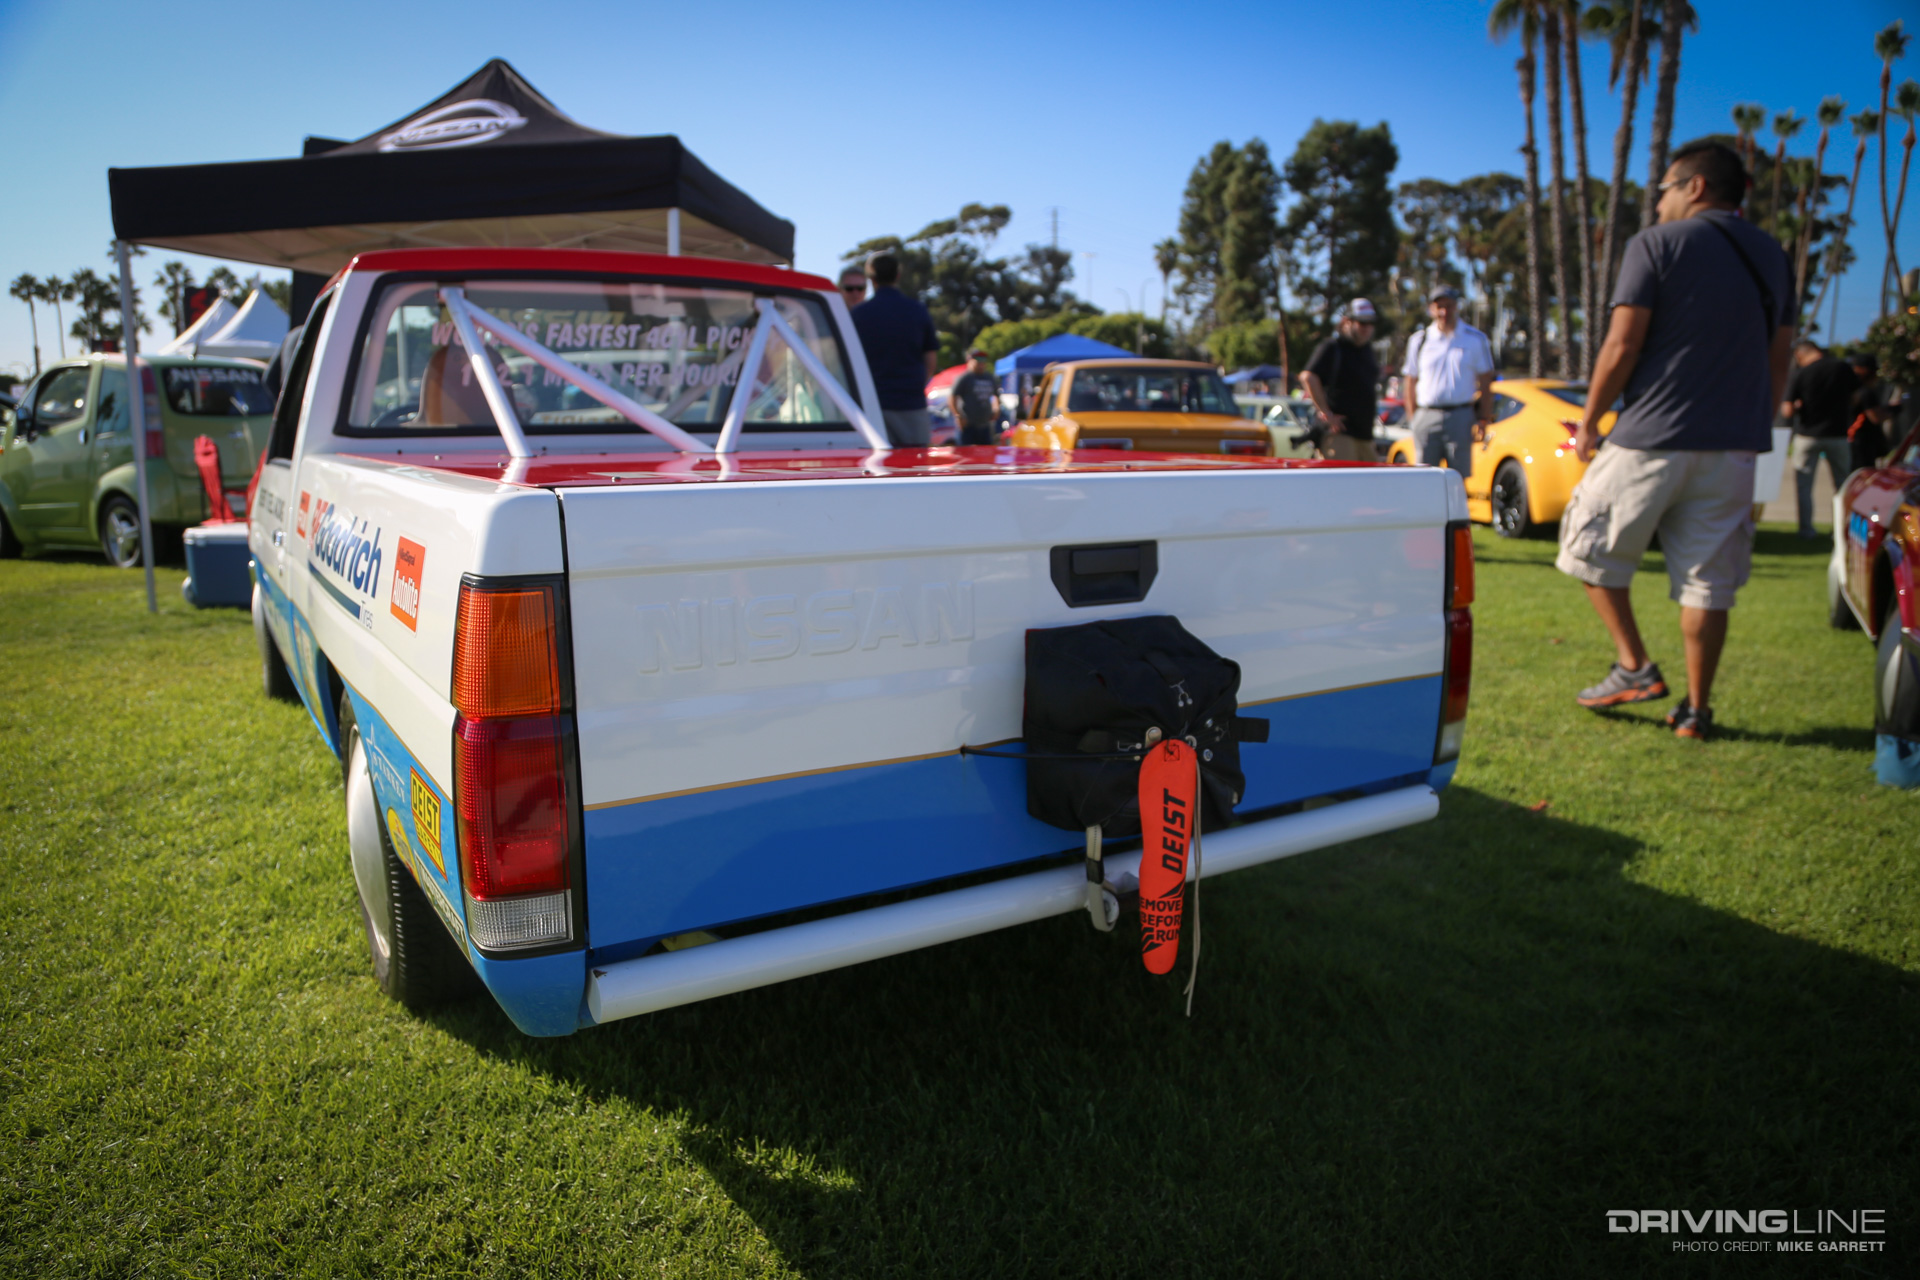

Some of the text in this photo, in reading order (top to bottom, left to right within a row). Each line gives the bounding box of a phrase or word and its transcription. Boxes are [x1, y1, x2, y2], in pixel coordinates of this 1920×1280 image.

[545, 322, 641, 349] FASTEST
[620, 363, 664, 387] PER
[670, 362, 741, 387] HOUR!
[392, 570, 419, 619] Autolite
[634, 580, 975, 675] NISSAN
[411, 777, 439, 837] DEIST
[1162, 788, 1186, 874] DEIST
